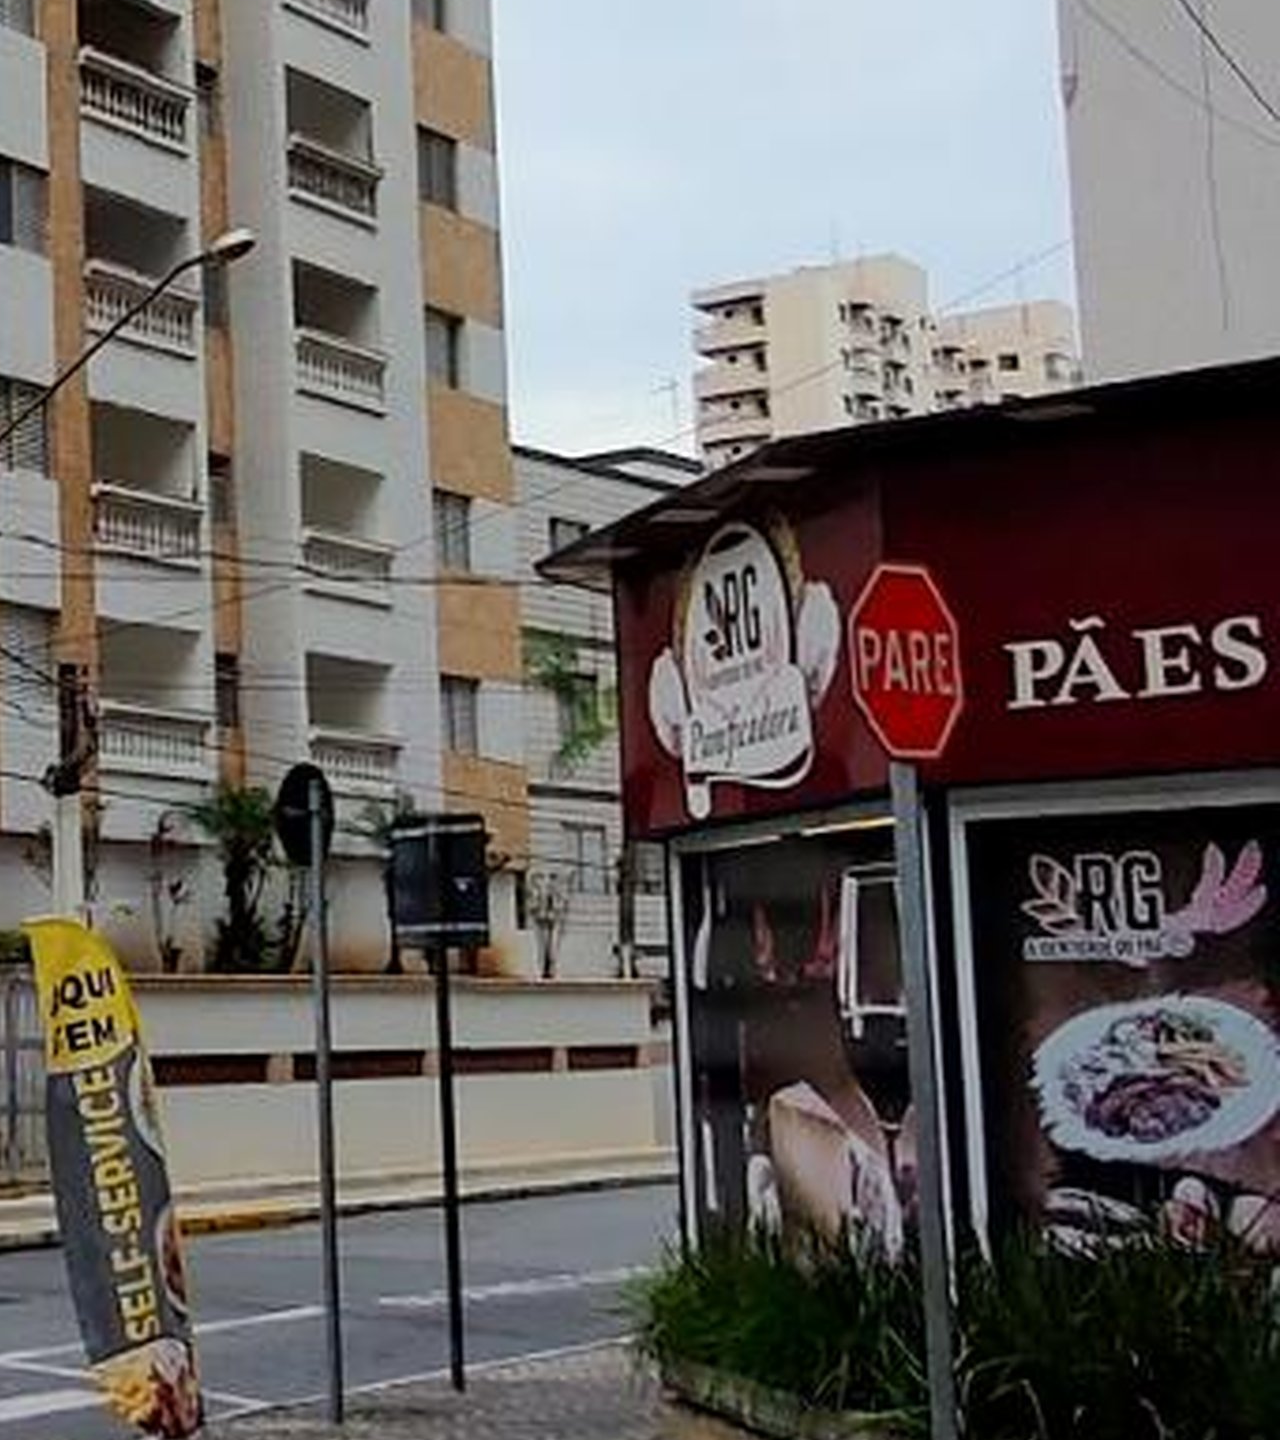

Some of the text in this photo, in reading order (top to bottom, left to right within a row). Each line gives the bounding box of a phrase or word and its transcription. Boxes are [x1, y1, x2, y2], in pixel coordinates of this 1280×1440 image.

[722, 564, 761, 659] RG
[857, 627, 955, 696] PARE
[1002, 615, 1268, 710] PÃES
[1073, 851, 1165, 933] RG
[72, 1065, 160, 1342] SELF-SERVICE
